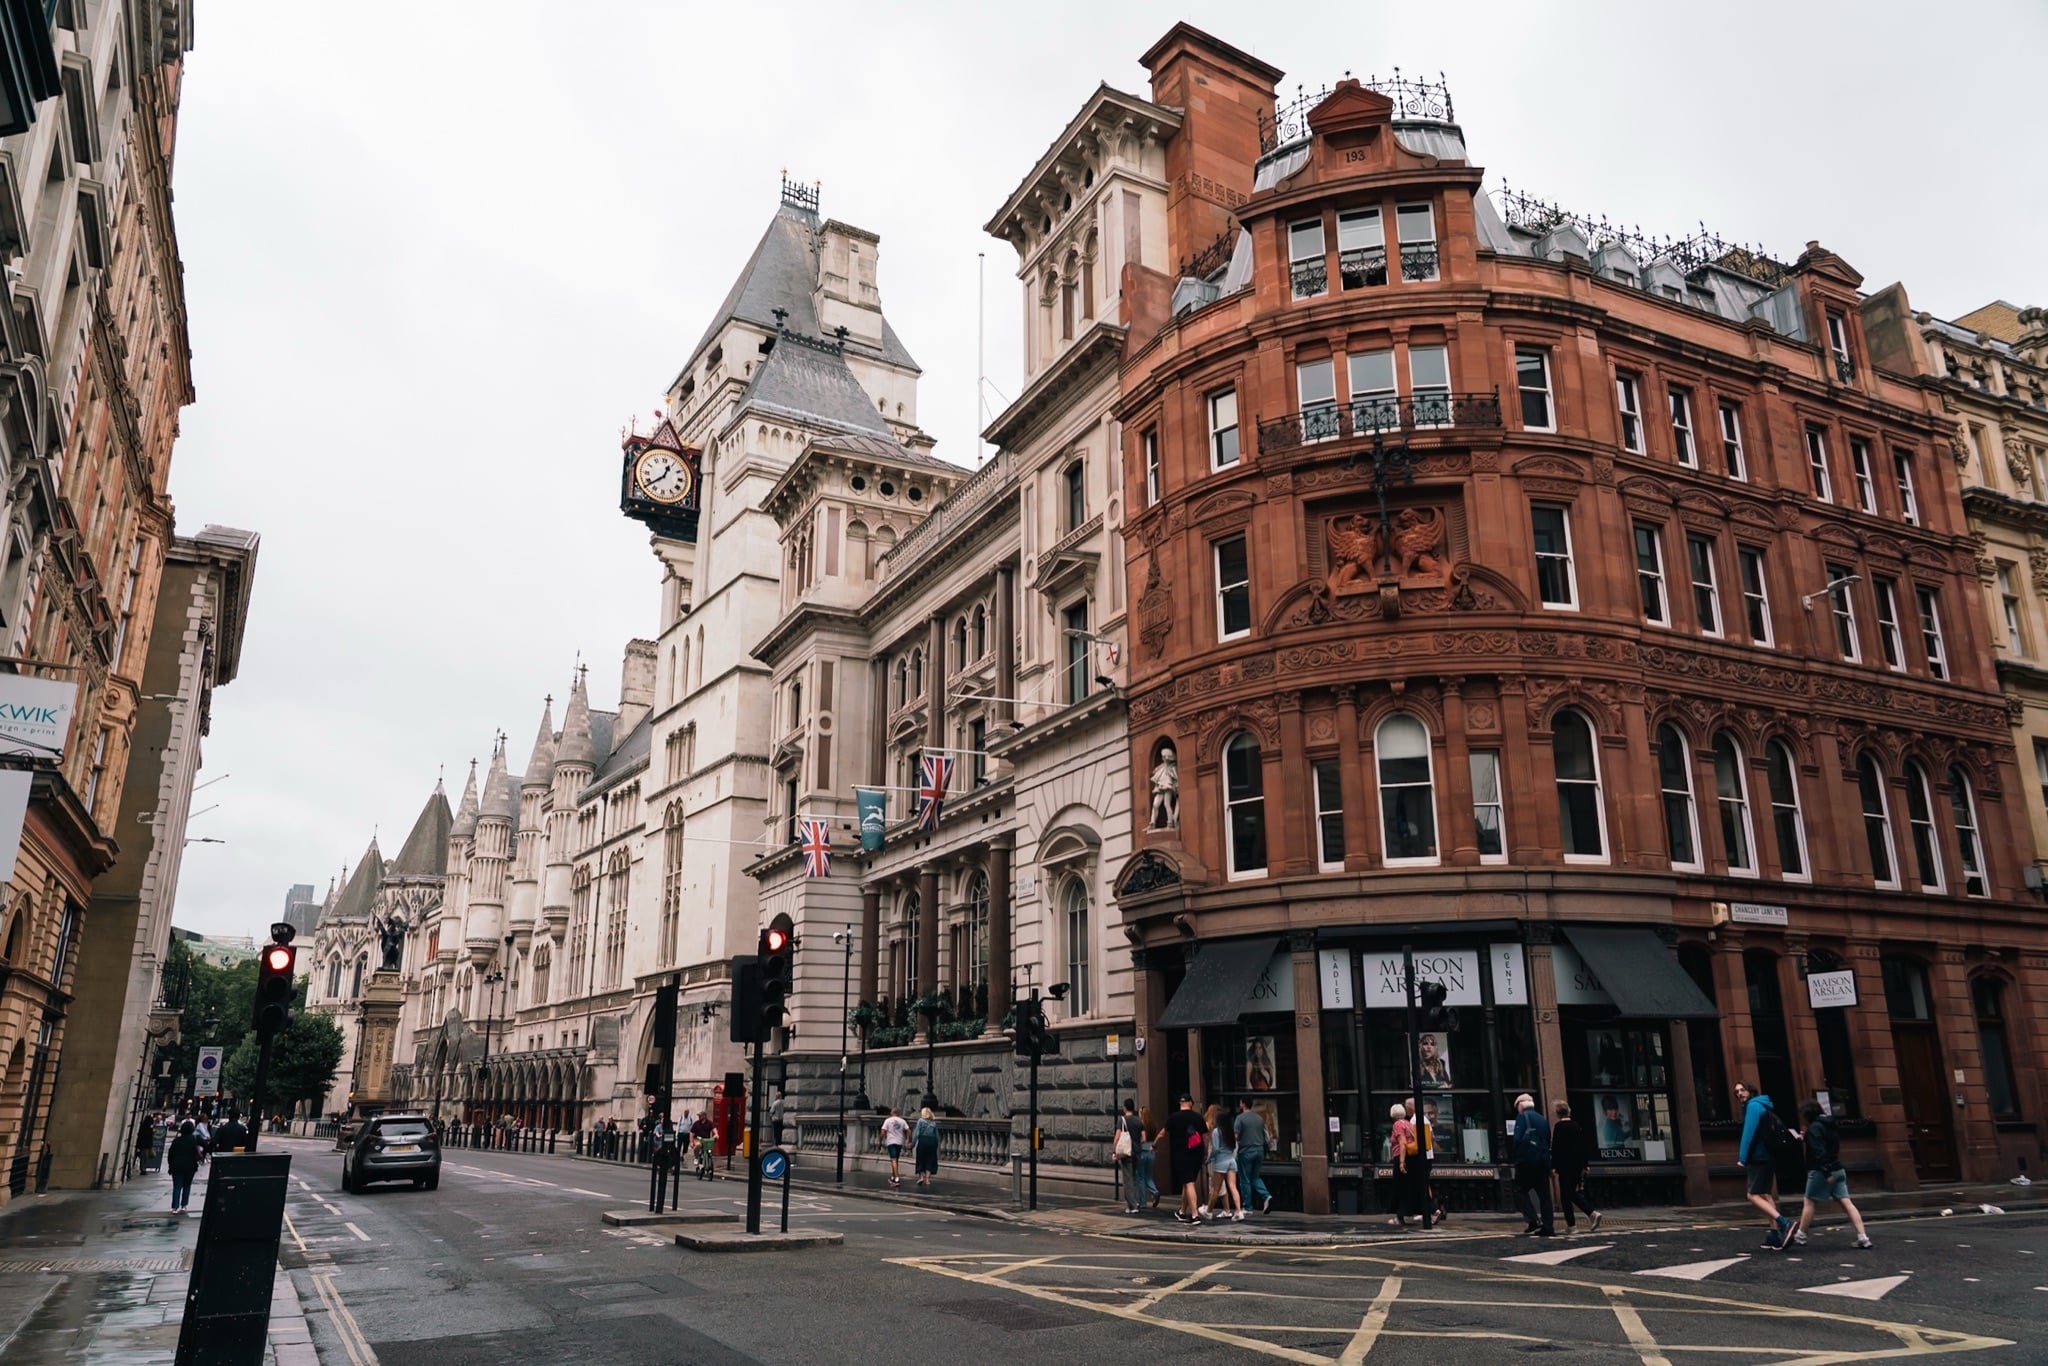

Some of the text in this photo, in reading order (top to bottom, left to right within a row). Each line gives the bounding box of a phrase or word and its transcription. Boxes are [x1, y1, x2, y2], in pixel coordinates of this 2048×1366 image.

[1345, 150, 1366, 163] 193
[30, 728, 56, 736] print
[1761, 906, 1774, 915] LANE
[1332, 954, 1341, 1004] LADIES
[1503, 952, 1513, 995] GENTS
[1380, 975, 1464, 993] ARSAN
[1813, 977, 1851, 988] MAISON
[1814, 985, 1853, 996] ARSLAN
[1600, 1149, 1635, 1158] REDKEN
